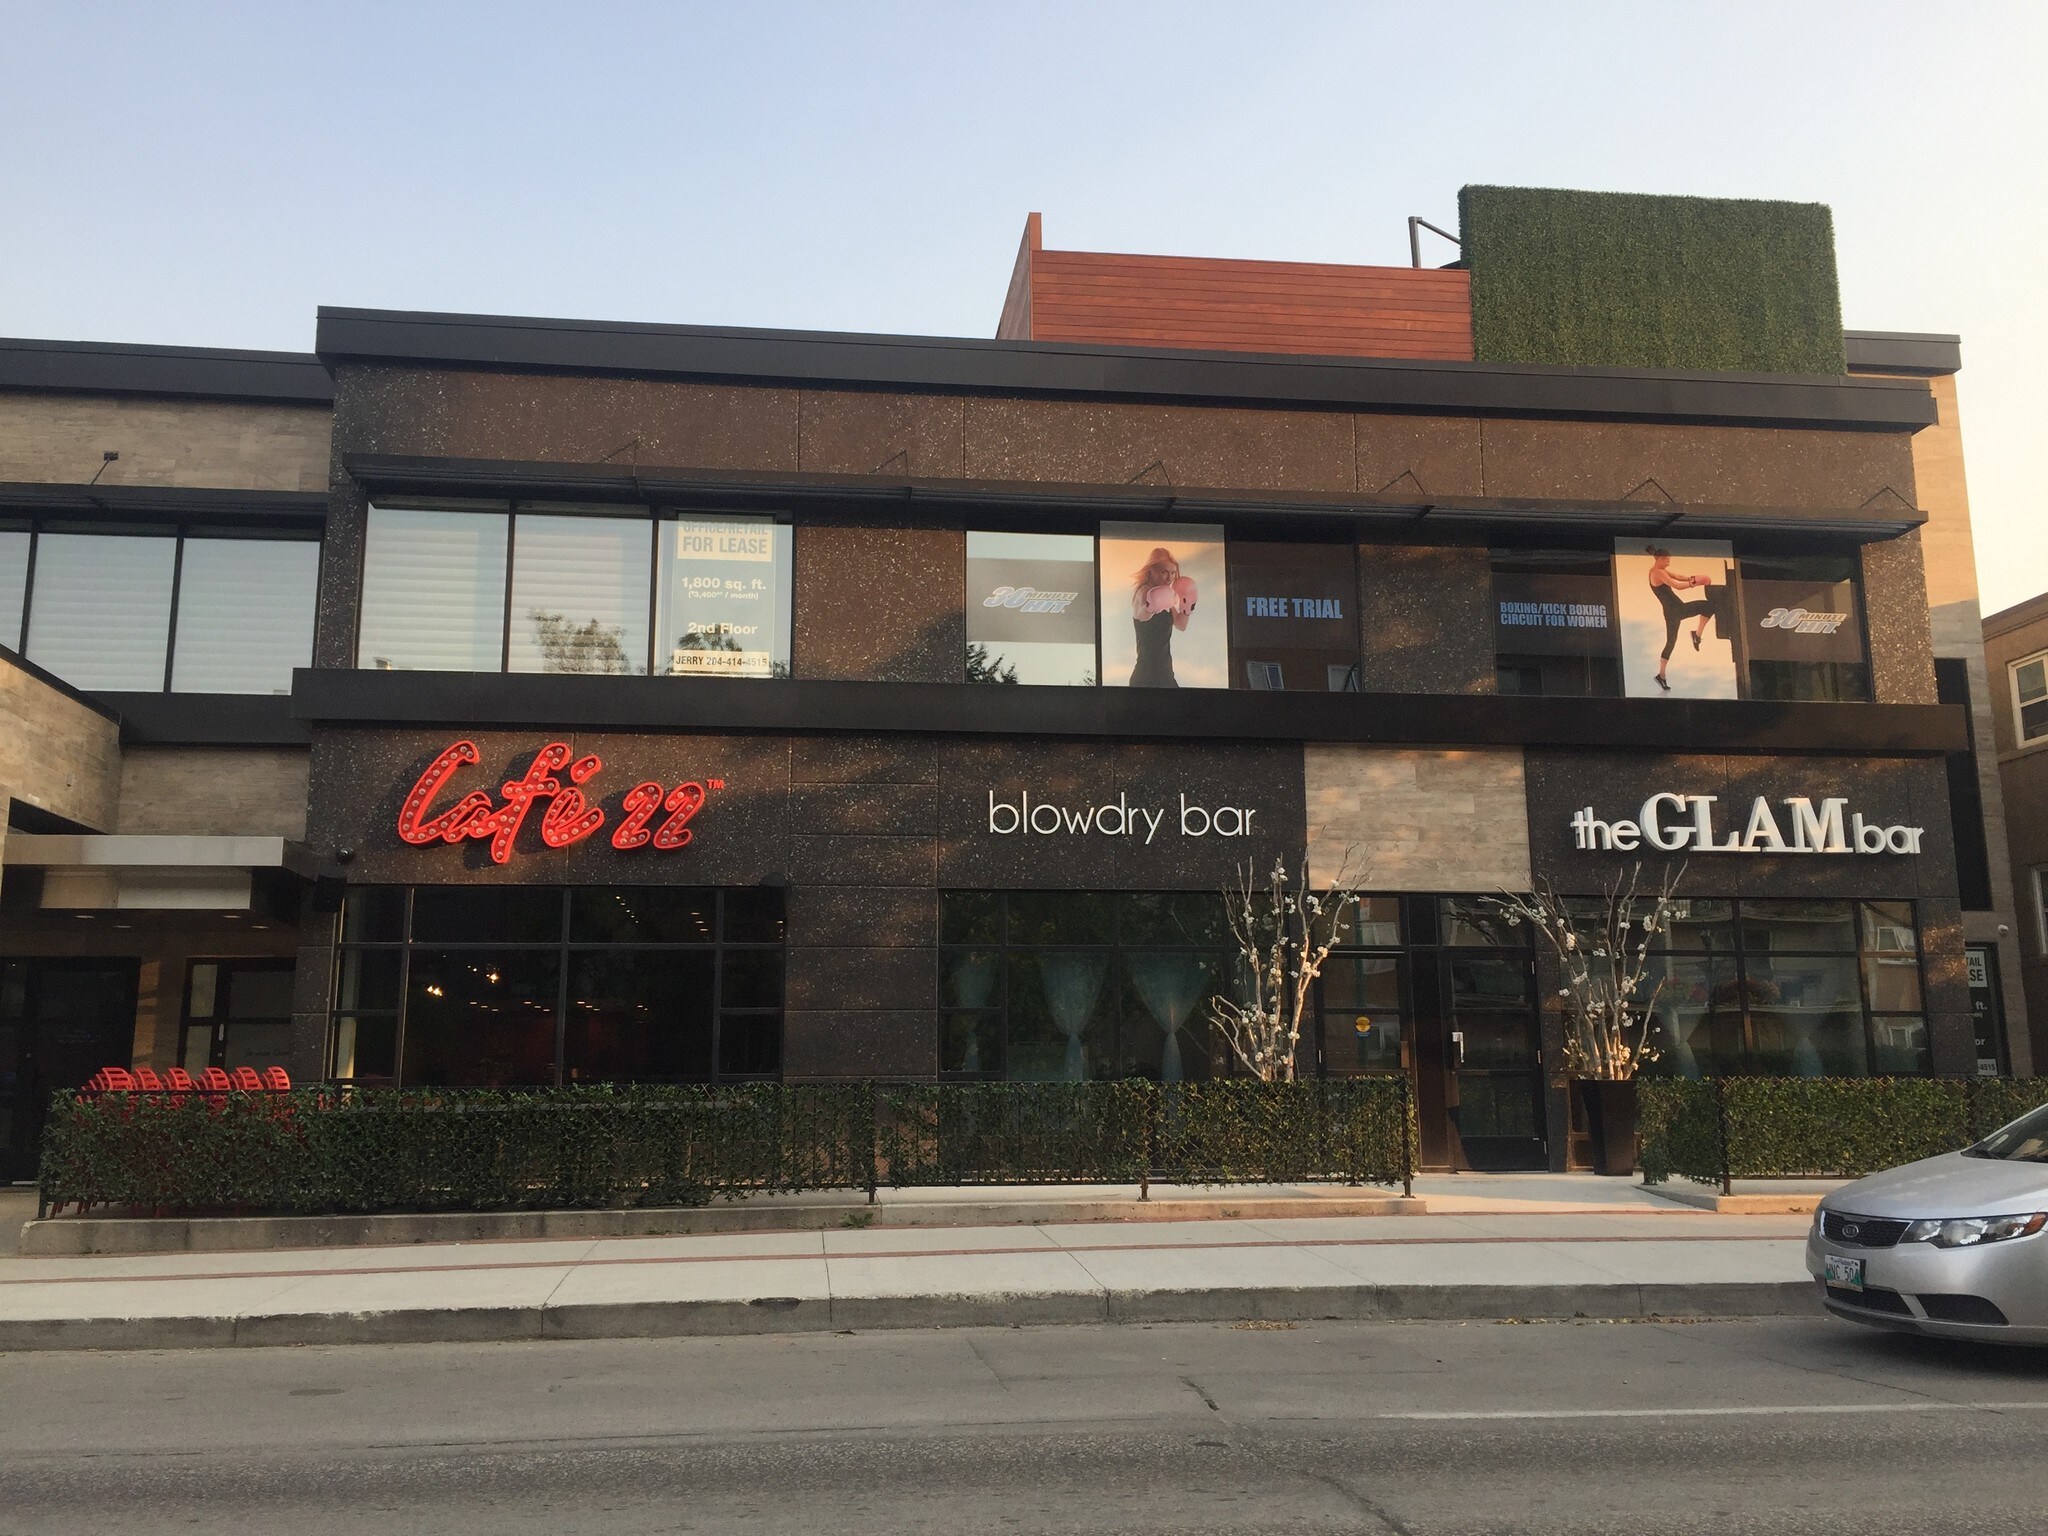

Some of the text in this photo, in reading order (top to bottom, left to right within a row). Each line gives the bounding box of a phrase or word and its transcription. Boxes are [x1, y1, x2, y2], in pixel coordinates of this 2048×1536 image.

[683, 536, 768, 554] FOR LEASE
[682, 577, 766, 591] 1,800 sq. ft.
[983, 586, 1078, 608] 30 MINUTE
[1246, 597, 1343, 619] FREE TRIAL
[1500, 602, 1607, 616] BOXING/KICK BOXING
[1500, 613, 1608, 628] CIRCUIT FOR WOMEN
[1760, 608, 1847, 629] 30 MINUTE
[688, 622, 758, 635] 2nd Floor
[675, 655, 767, 667] JERRY 204-414-4515
[611, 782, 706, 849] 22
[989, 790, 1256, 844] blowdry bar
